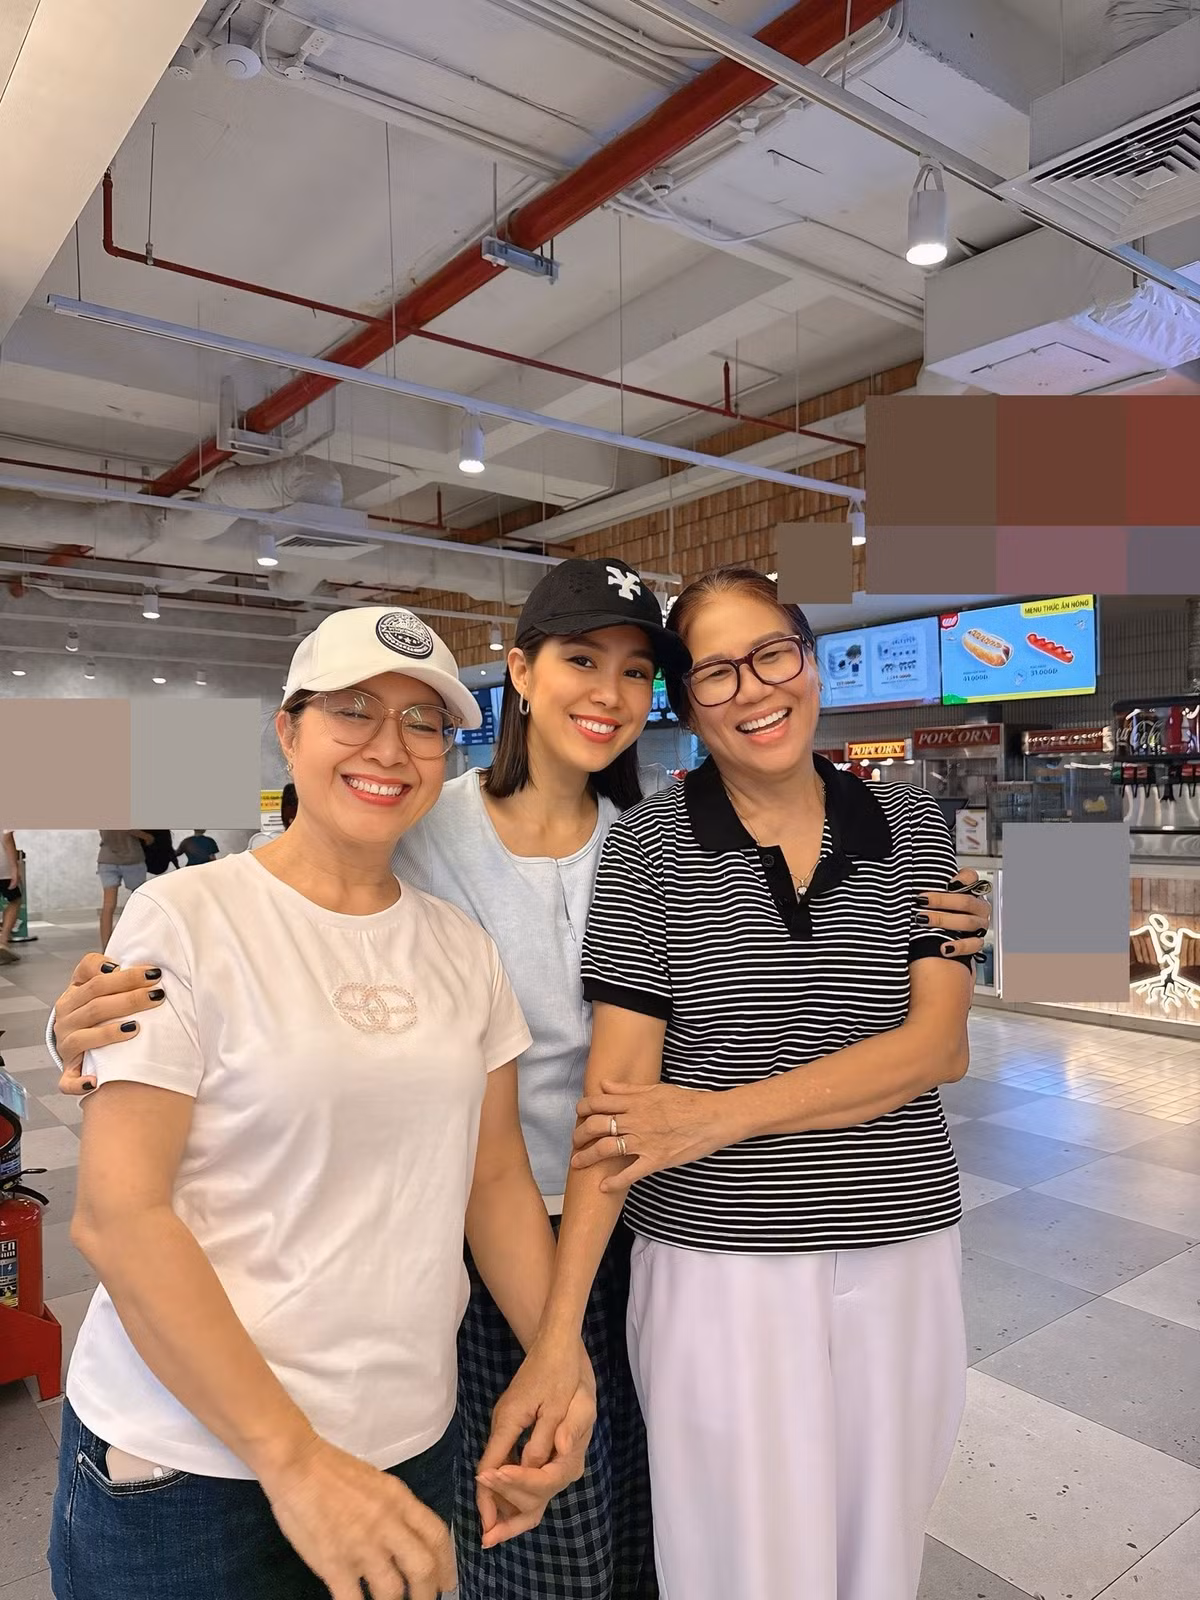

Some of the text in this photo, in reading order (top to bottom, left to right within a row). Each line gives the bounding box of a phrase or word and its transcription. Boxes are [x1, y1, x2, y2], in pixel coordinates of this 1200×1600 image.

[1024, 606, 1042, 614] MENU
[918, 729, 993, 745] POPCORN
[850, 744, 901, 755] POPCORN
